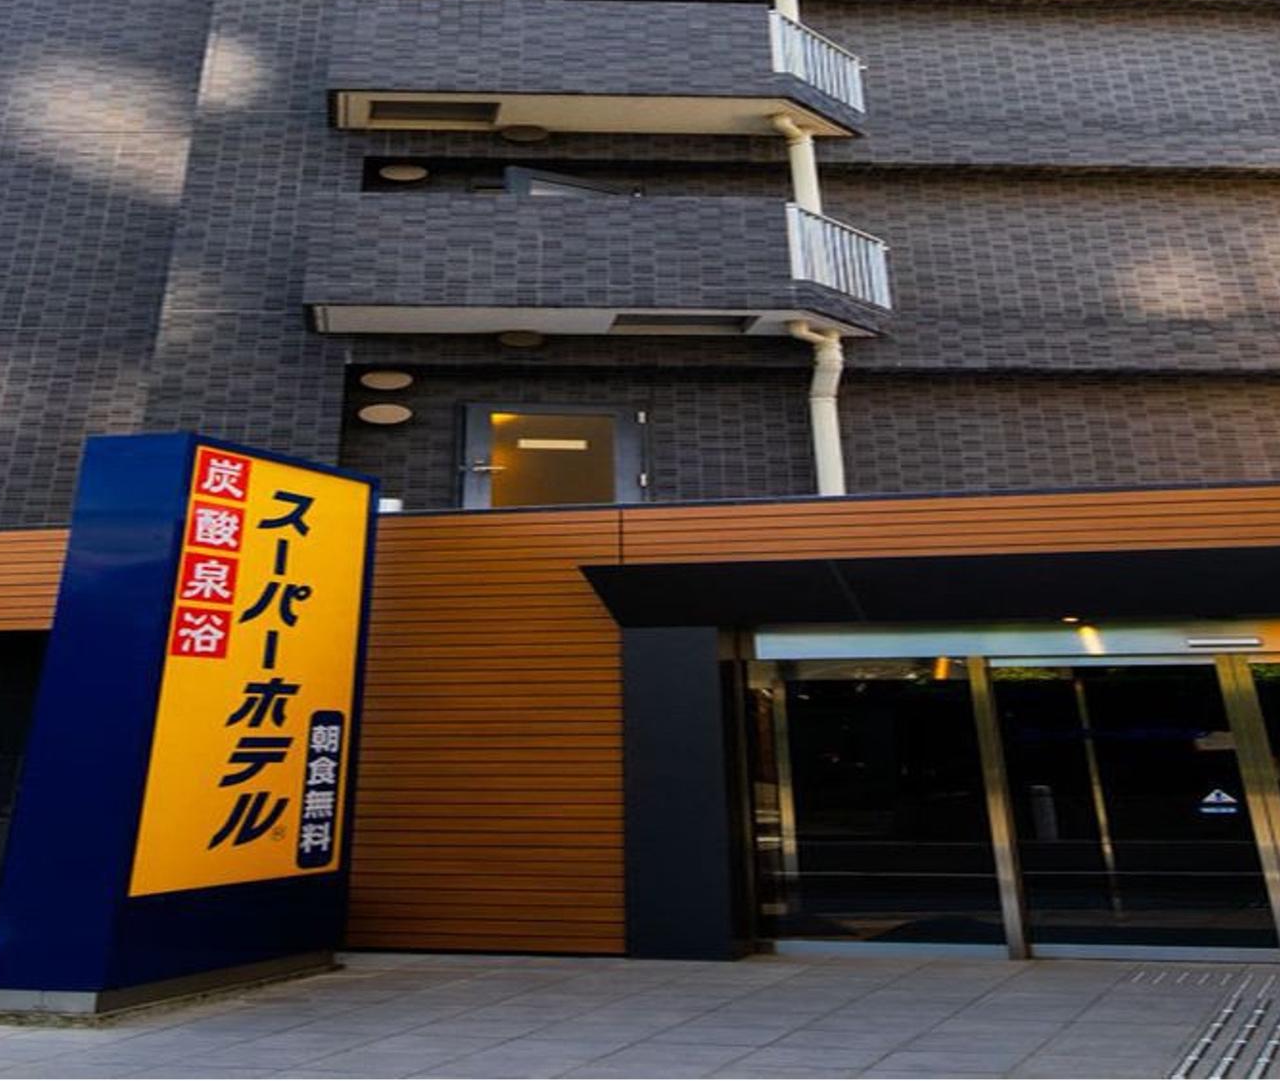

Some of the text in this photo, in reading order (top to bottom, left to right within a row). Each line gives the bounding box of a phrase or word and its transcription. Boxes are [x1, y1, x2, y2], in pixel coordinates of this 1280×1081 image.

[177, 459, 244, 653] 炭酸泉浴
[207, 490, 315, 850] スーパーホテル
[300, 724, 341, 853] 朝食無料
